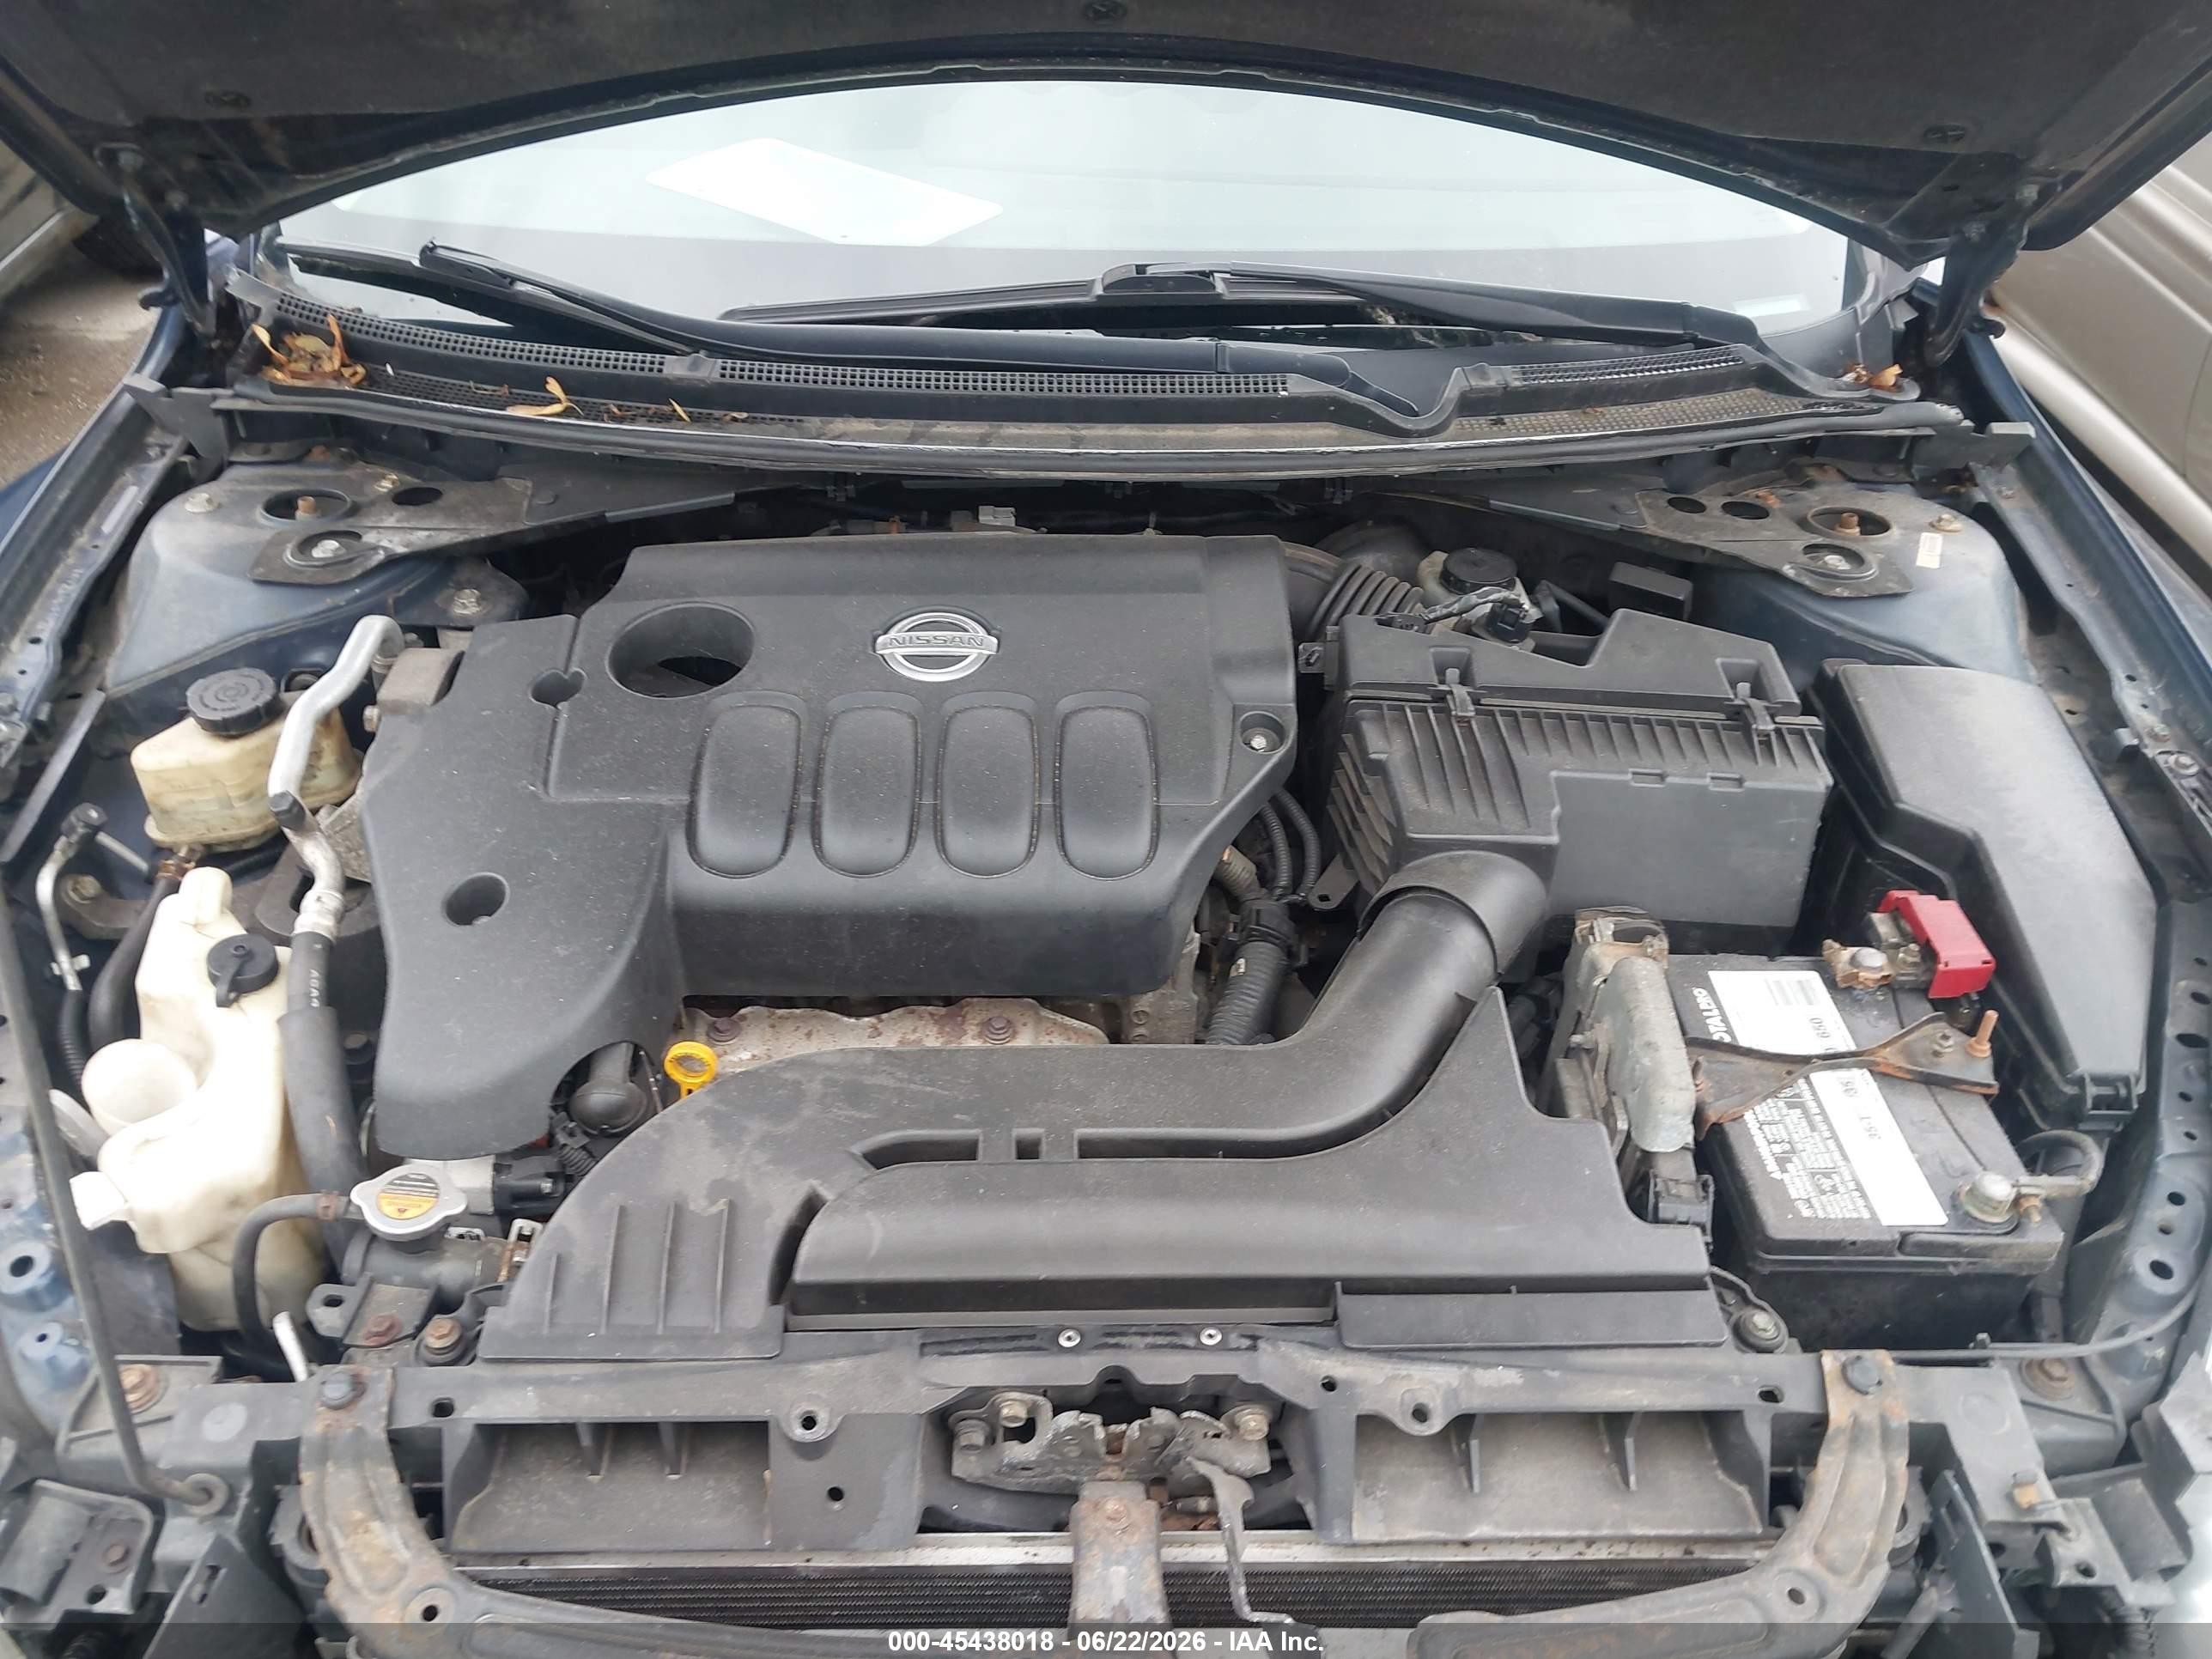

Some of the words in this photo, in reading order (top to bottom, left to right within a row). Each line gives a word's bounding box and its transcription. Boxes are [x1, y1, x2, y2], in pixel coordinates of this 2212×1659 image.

[889, 635, 984, 647] NISSAN
[1692, 988, 1732, 1042] OTALPRO
[1809, 1017, 1831, 1038] 650
